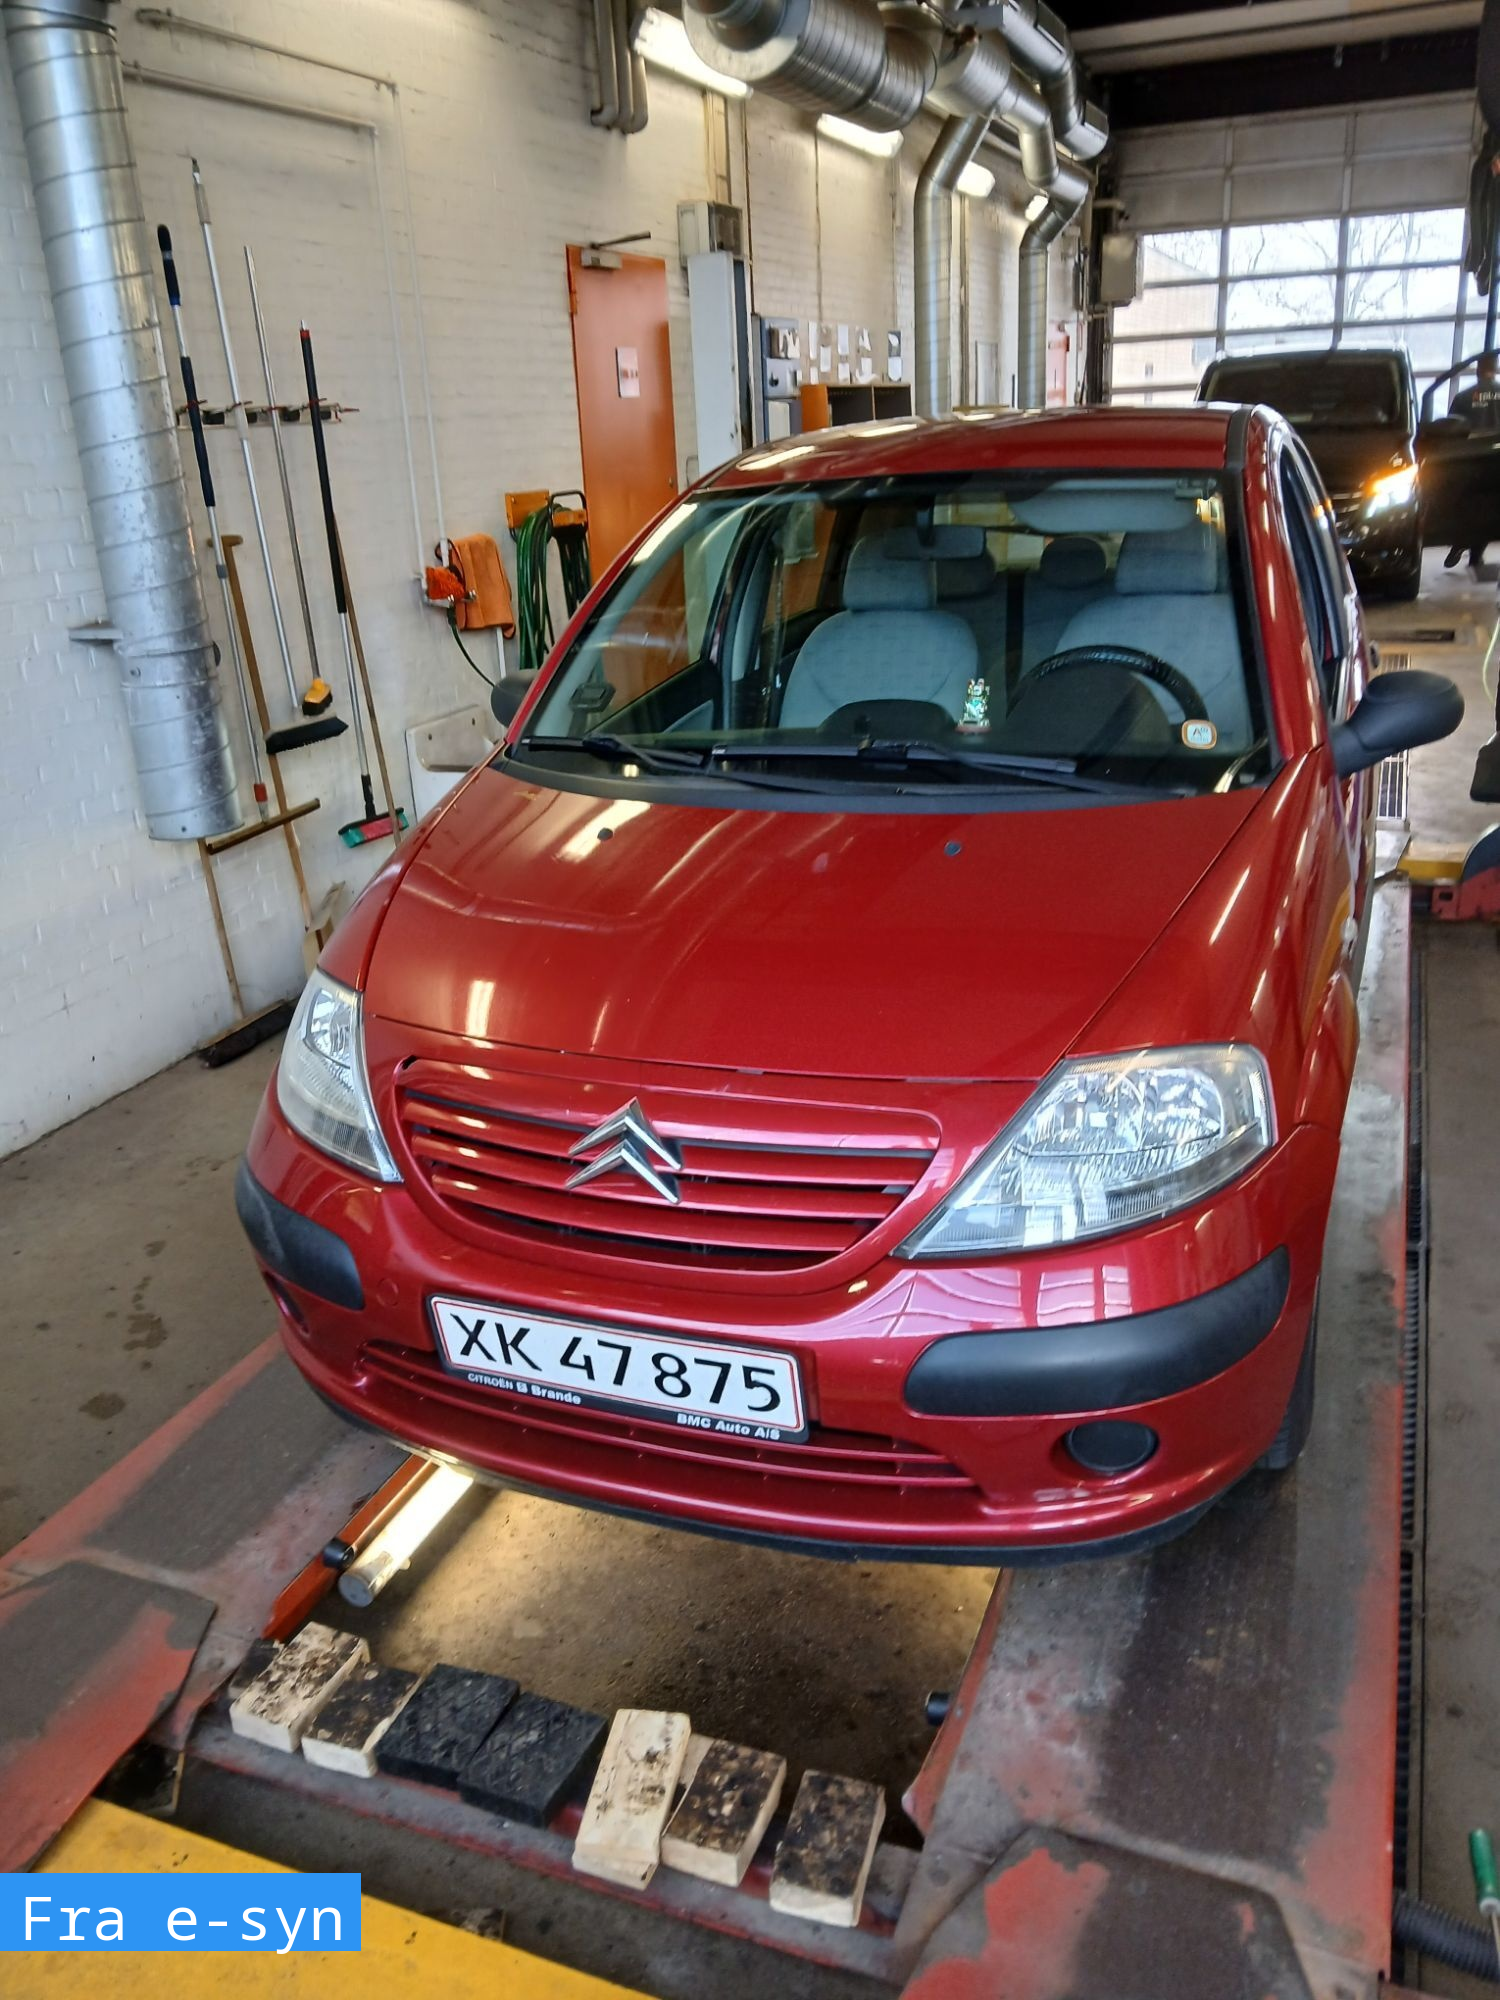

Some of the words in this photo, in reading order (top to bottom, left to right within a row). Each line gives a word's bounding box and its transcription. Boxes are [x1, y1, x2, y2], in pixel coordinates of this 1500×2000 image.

[450, 1313, 542, 1372] XK
[560, 1336, 632, 1386] 47
[651, 1351, 782, 1412] 875
[531, 1385, 582, 1405] Brande
[715, 1420, 751, 1435] Auto
[754, 1426, 780, 1441] A/S
